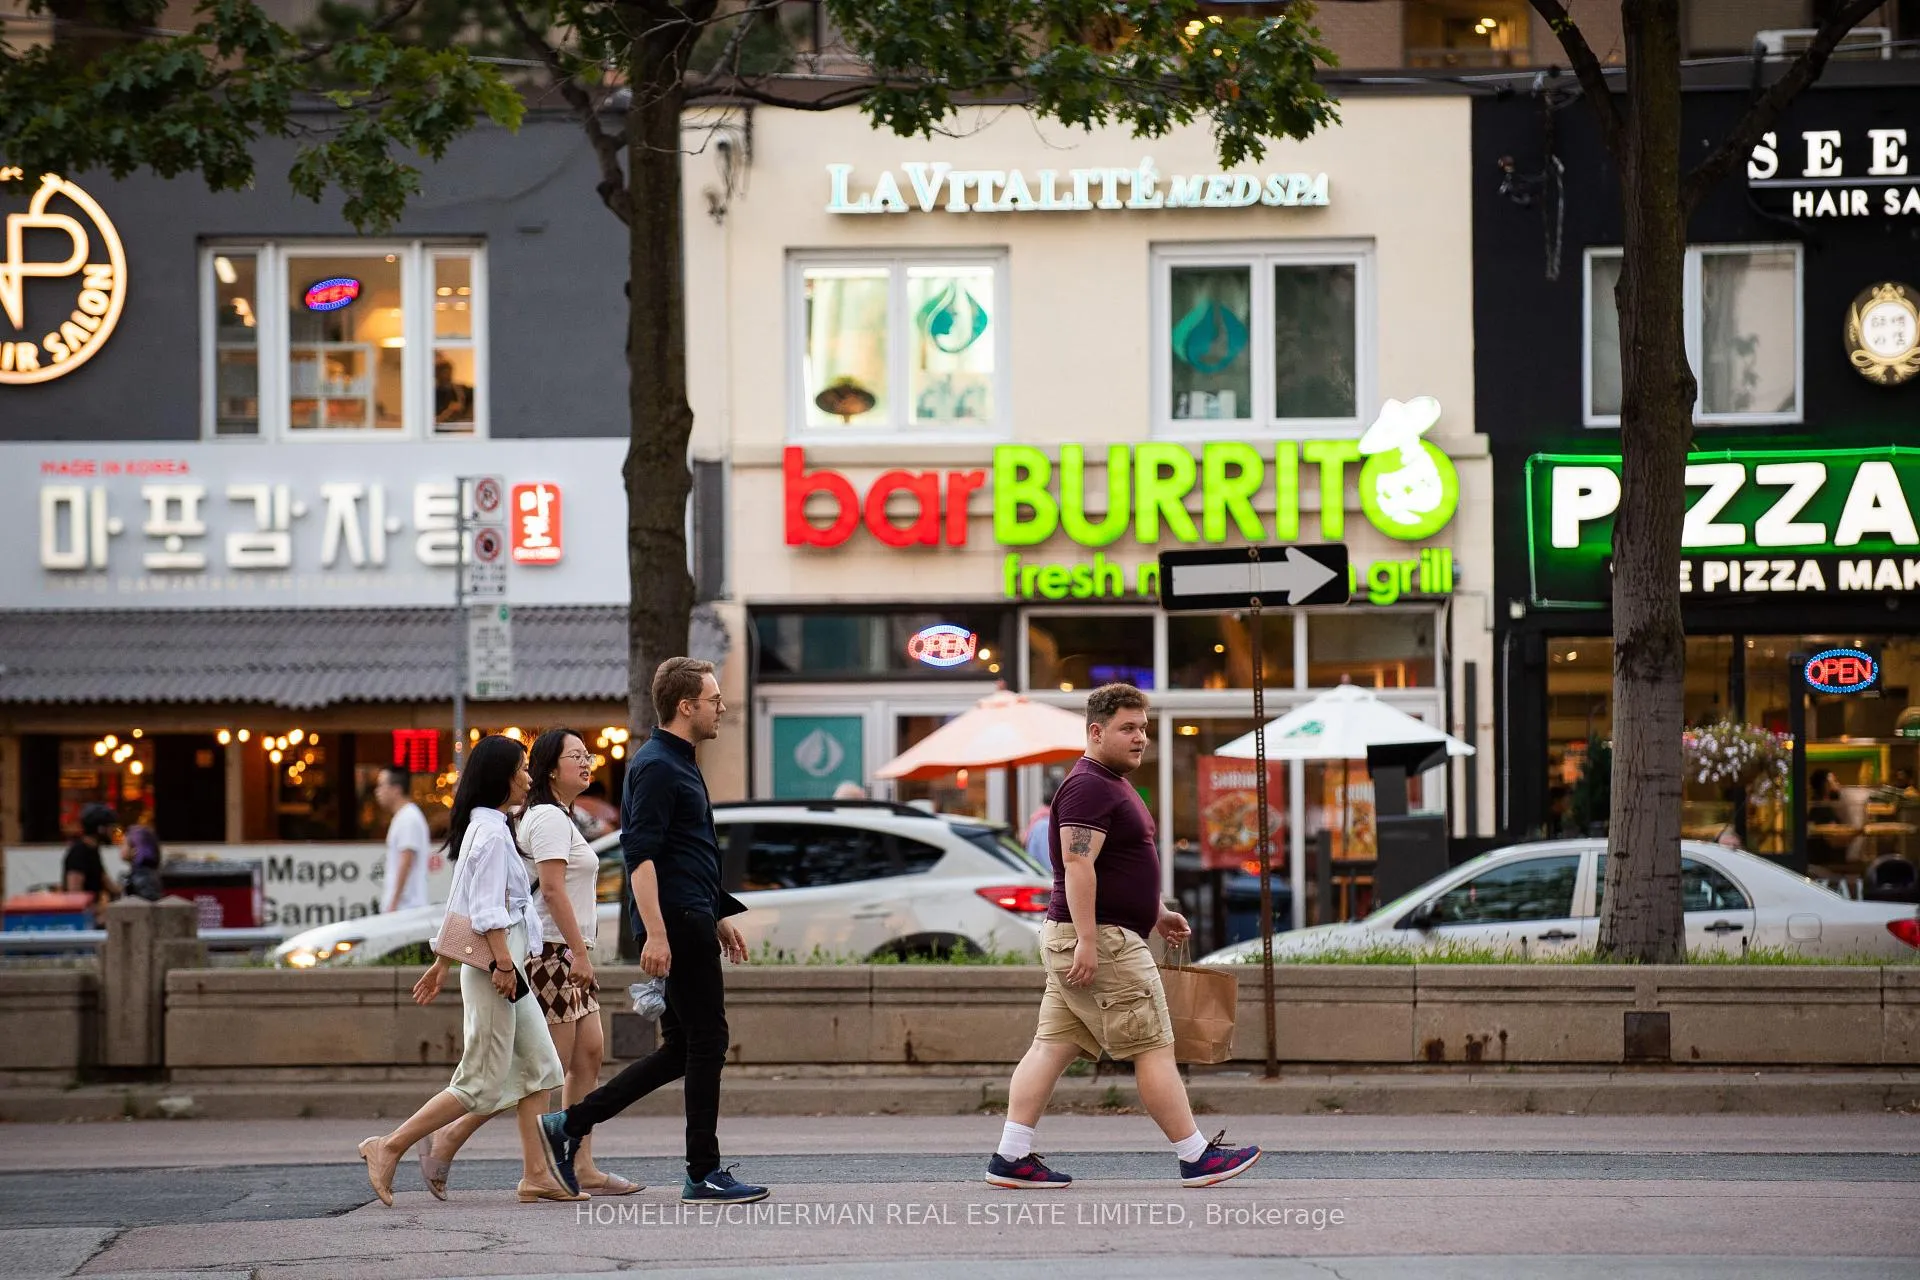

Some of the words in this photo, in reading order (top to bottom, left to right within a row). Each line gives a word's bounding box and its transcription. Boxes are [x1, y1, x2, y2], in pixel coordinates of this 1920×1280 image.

[1166, 174, 1261, 207] MED
[1262, 172, 1331, 206] SPA
[1793, 188, 1870, 217] HAIR
[43, 263, 113, 363] SALON
[1552, 461, 1920, 549] PZZA
[1003, 551, 1124, 599] fresh
[1368, 547, 1453, 605] grill
[1703, 559, 1826, 592] PIZZA
[907, 633, 976, 660] OPEN
[1808, 657, 1872, 685] OPEN
[267, 855, 360, 889] Mapo
